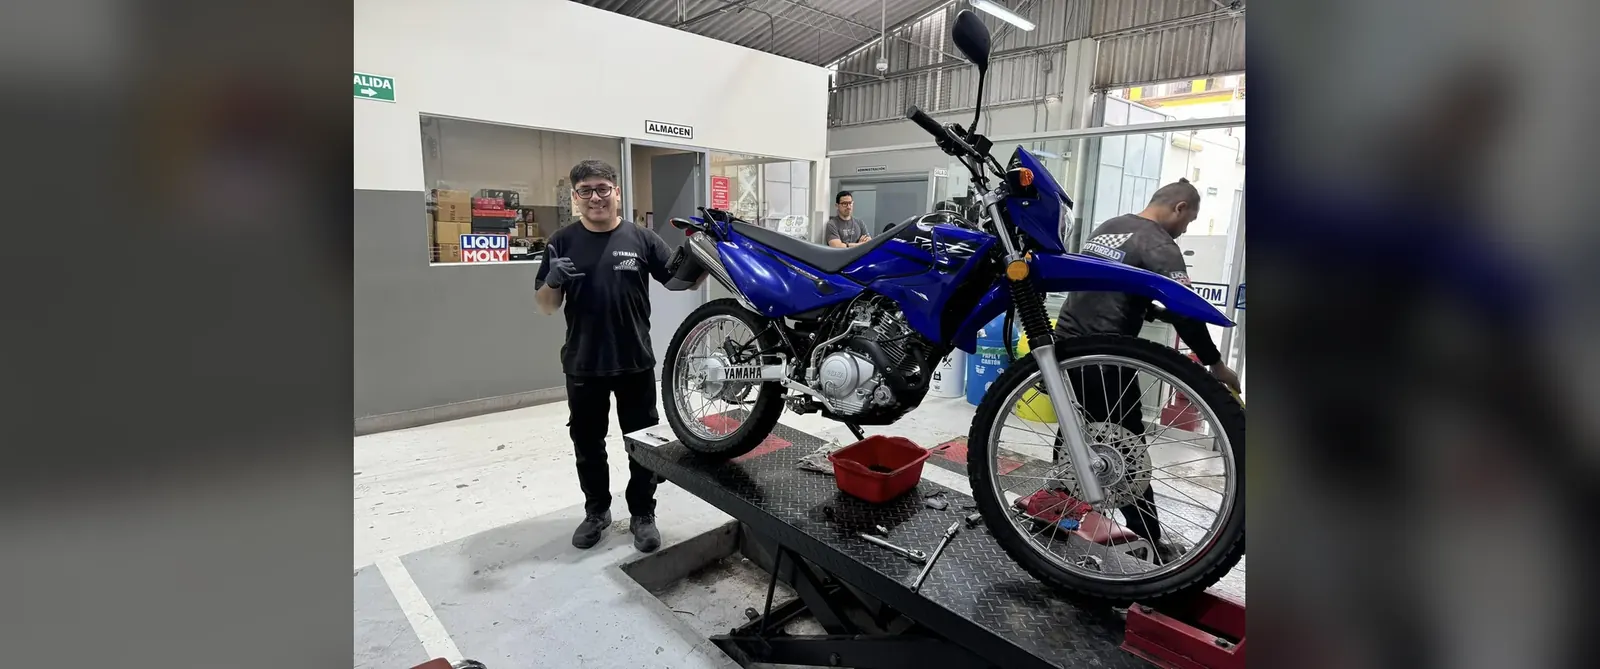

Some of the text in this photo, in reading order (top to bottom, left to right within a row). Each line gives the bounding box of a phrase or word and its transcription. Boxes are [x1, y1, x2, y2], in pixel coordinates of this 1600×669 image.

[649, 124, 691, 136] ALMACEN
[463, 236, 506, 249] LIQUI
[464, 250, 506, 262] MOLY
[724, 367, 762, 379] YAMAHA
